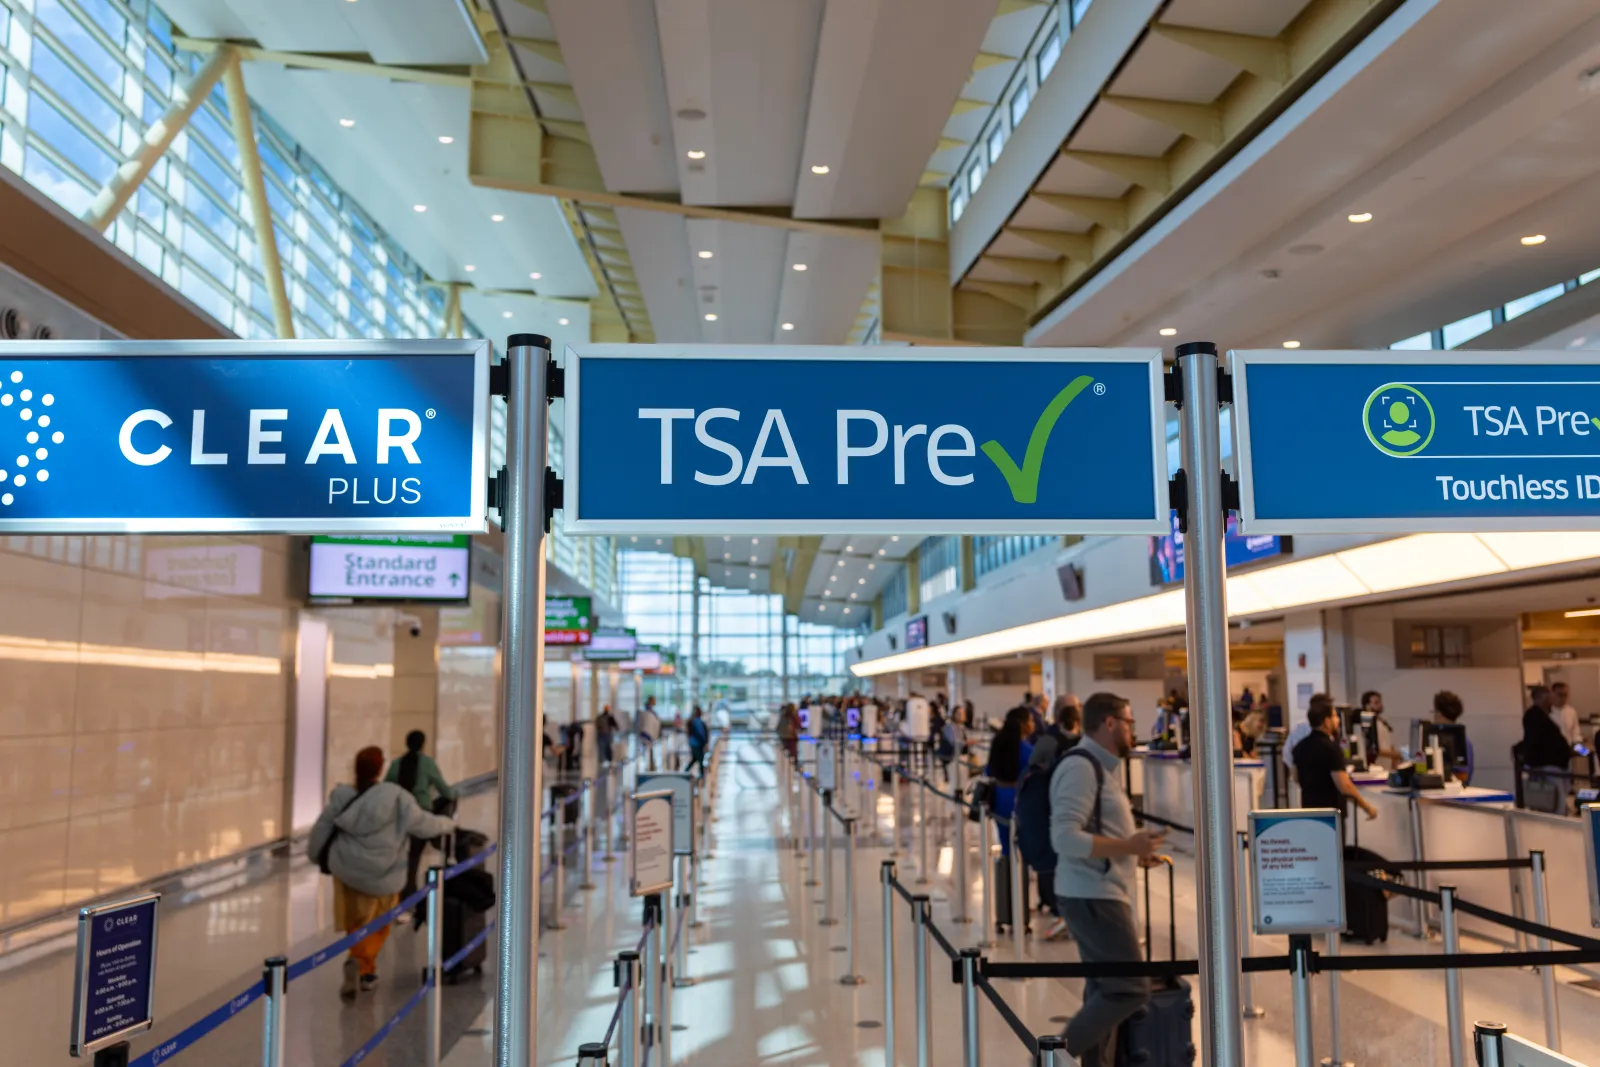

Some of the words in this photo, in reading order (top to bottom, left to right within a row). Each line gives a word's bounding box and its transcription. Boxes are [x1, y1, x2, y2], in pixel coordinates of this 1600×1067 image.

[1463, 405, 1529, 437] TSA
[1535, 405, 1590, 437] Pre
[638, 407, 810, 486] TSA
[836, 409, 976, 486] Pre
[328, 477, 421, 505] PLUS
[1435, 474, 1569, 501] Touchless
[1576, 474, 1600, 499] ID
[345, 554, 437, 571] Standard
[345, 569, 436, 587] Entrance
[116, 914, 138, 926] CLEAR
